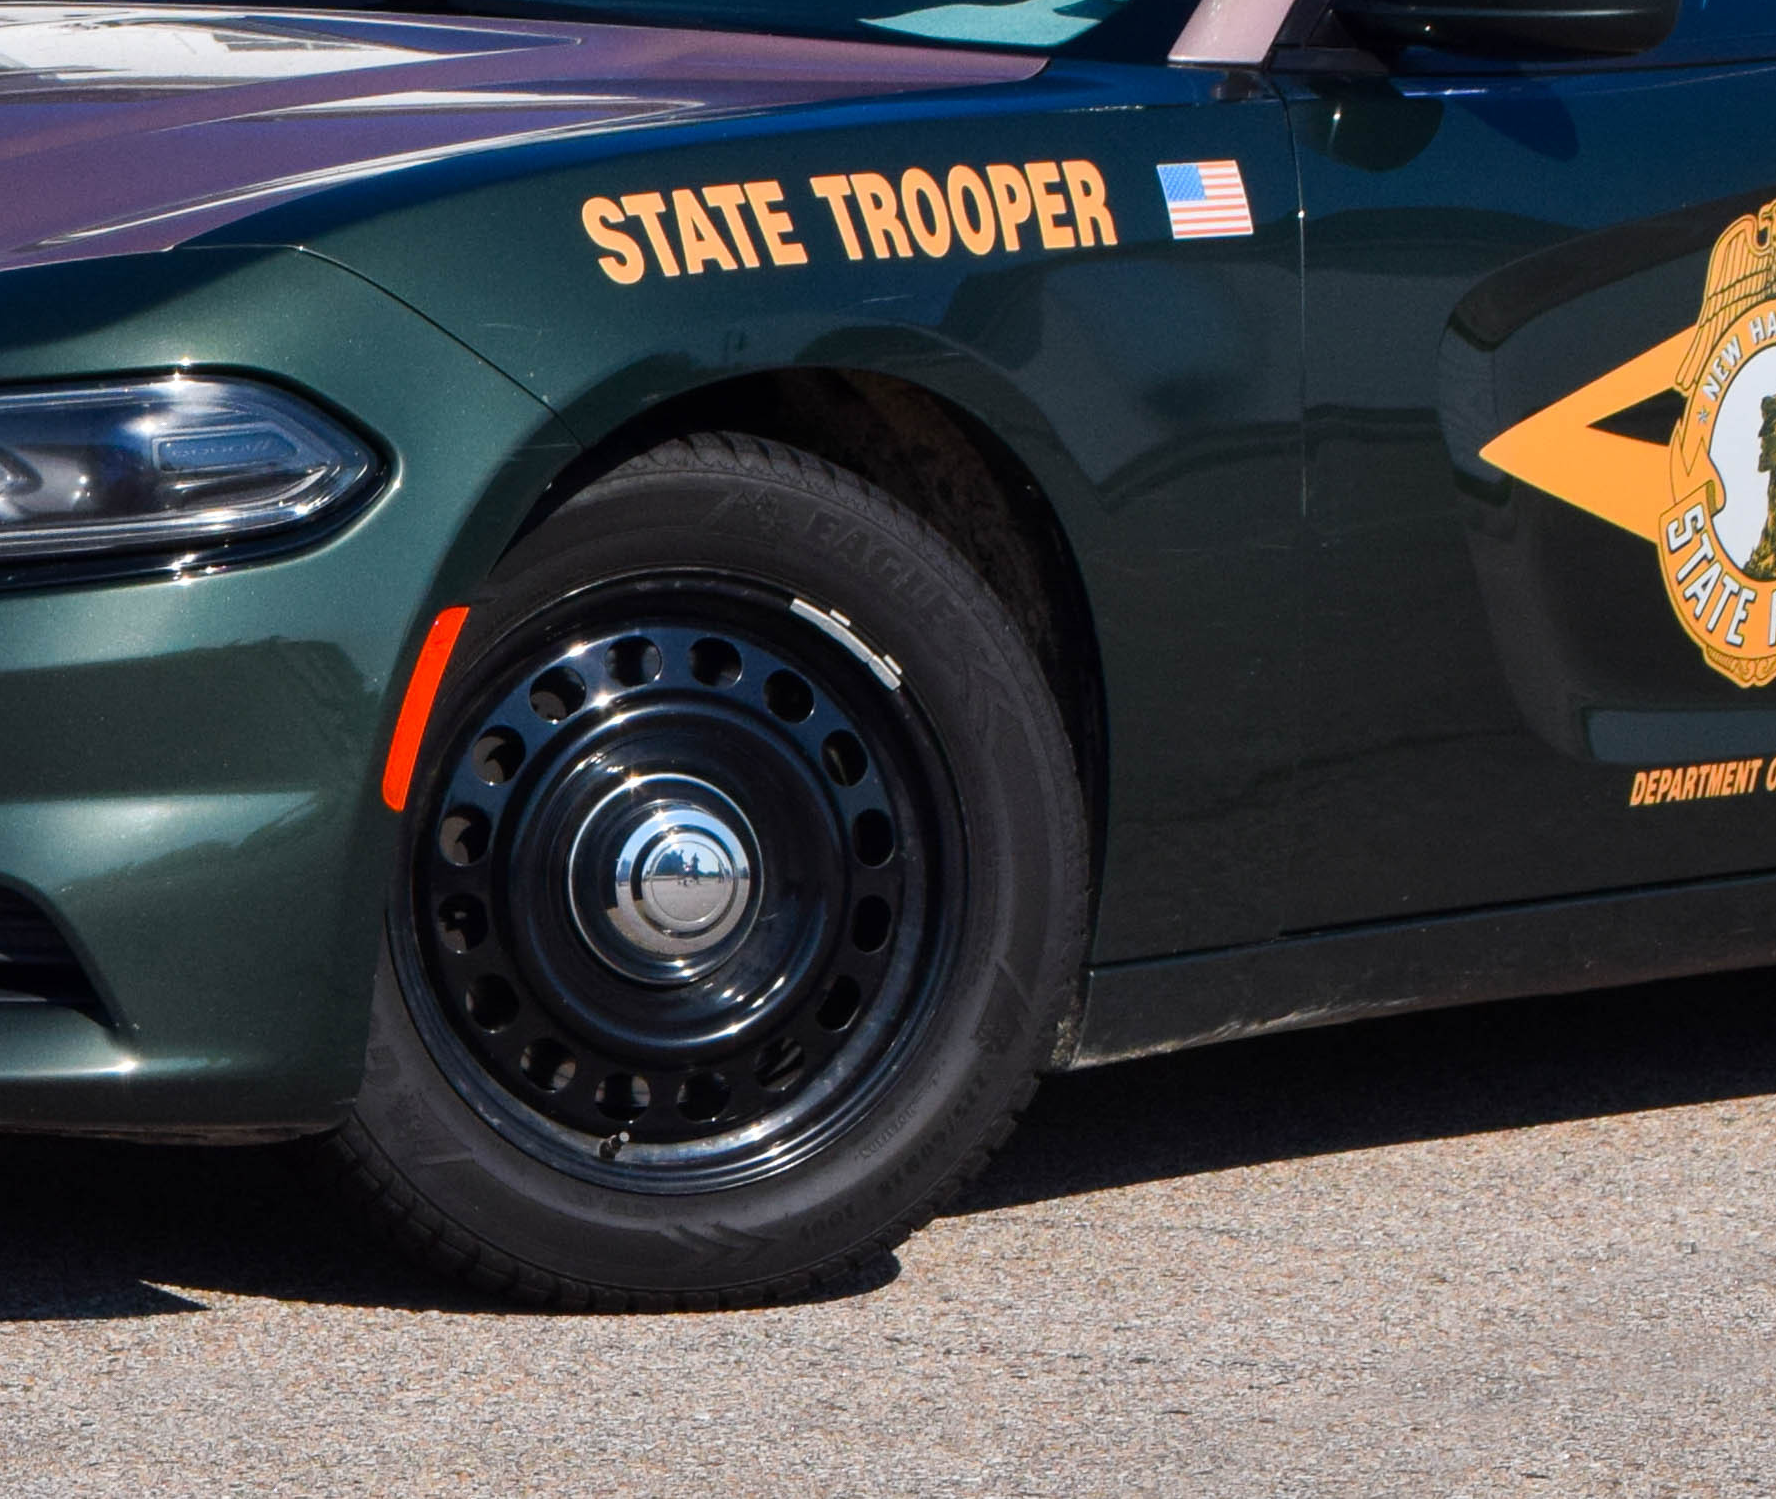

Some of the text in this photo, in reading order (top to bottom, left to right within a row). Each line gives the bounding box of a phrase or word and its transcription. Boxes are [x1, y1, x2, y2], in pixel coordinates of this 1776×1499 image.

[582, 160, 1118, 285] STATE TROOPER
[1701, 335, 1743, 401] NEW
[1667, 502, 1758, 648] STATE
[1629, 758, 1760, 807] DEPARTMENT
